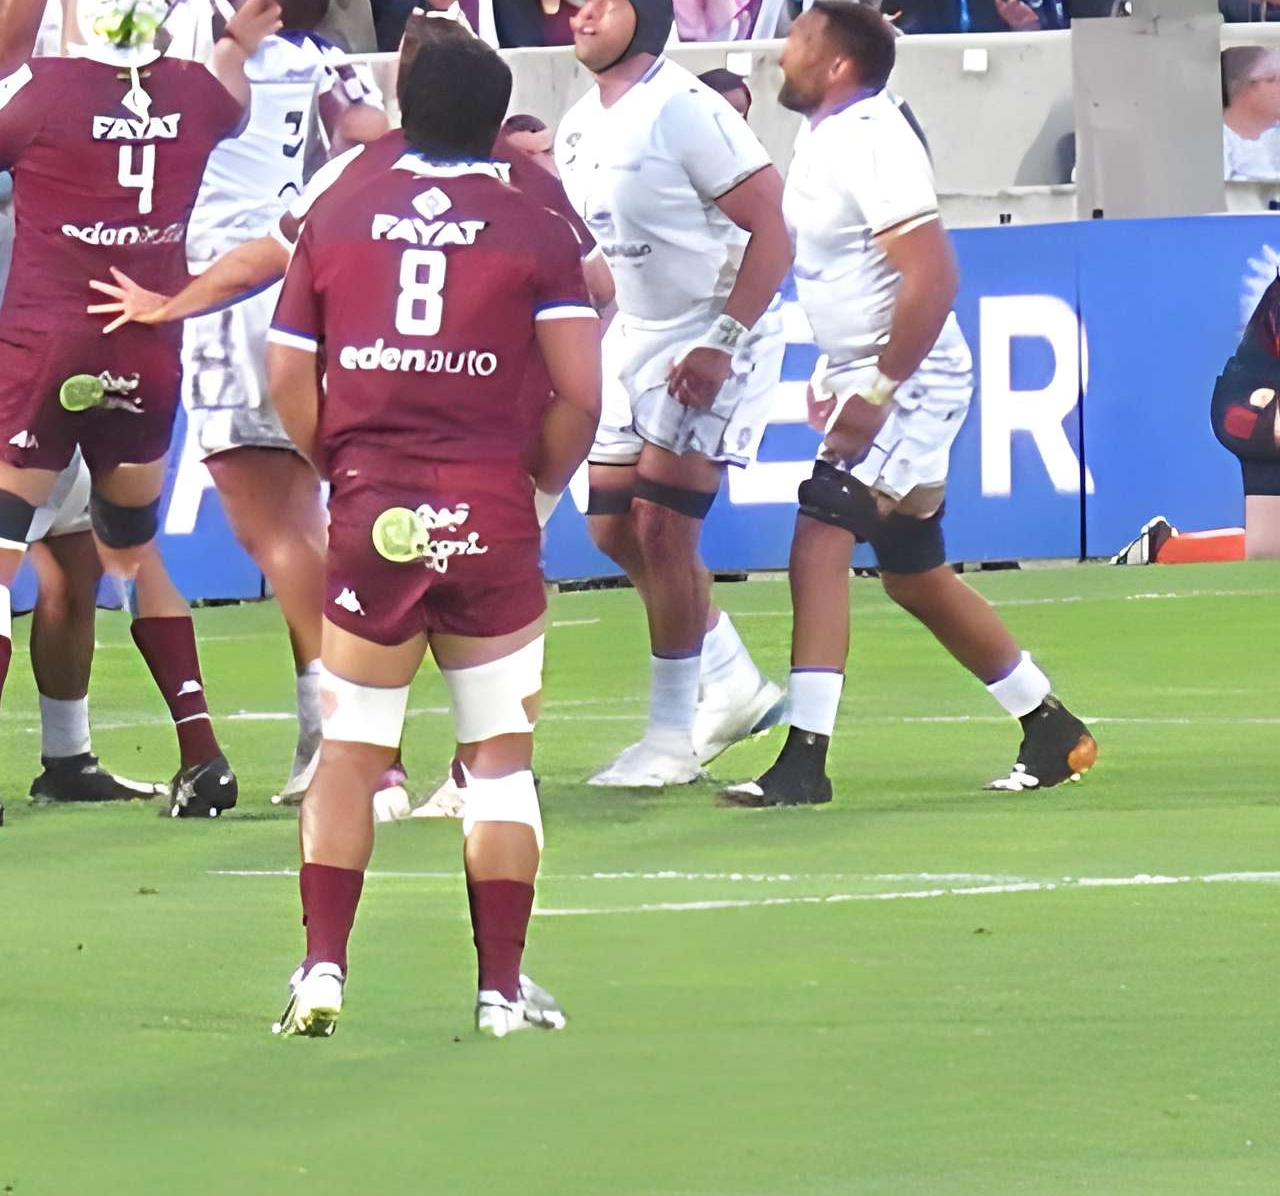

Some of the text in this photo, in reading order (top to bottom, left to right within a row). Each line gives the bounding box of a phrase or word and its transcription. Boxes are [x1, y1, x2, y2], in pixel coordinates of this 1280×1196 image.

[118, 144, 155, 214] 4
[395, 248, 447, 336] 8
[340, 338, 497, 376] edenauto
